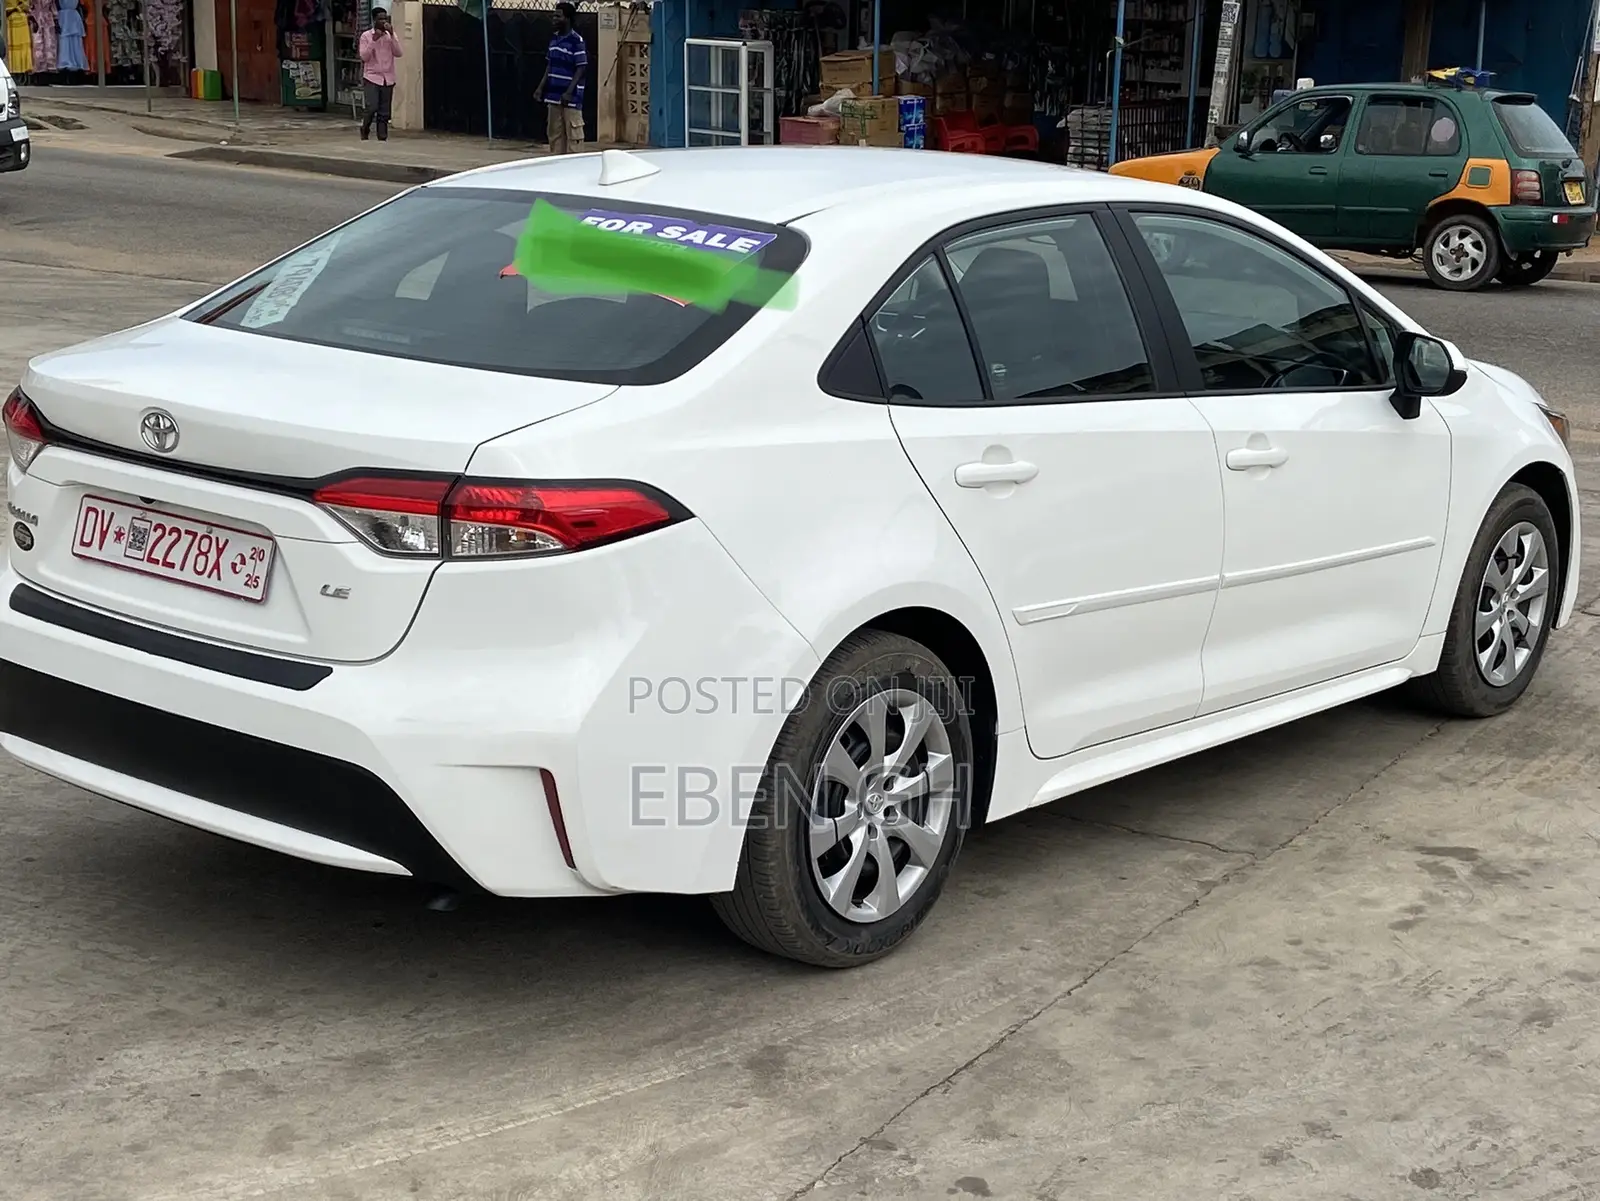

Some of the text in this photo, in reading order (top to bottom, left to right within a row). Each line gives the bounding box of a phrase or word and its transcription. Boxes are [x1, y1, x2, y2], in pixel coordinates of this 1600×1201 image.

[581, 216, 653, 235] FOR
[657, 225, 762, 254] SALE
[79, 506, 115, 551] DV
[146, 523, 230, 581] 2278X
[320, 584, 352, 600] LE
